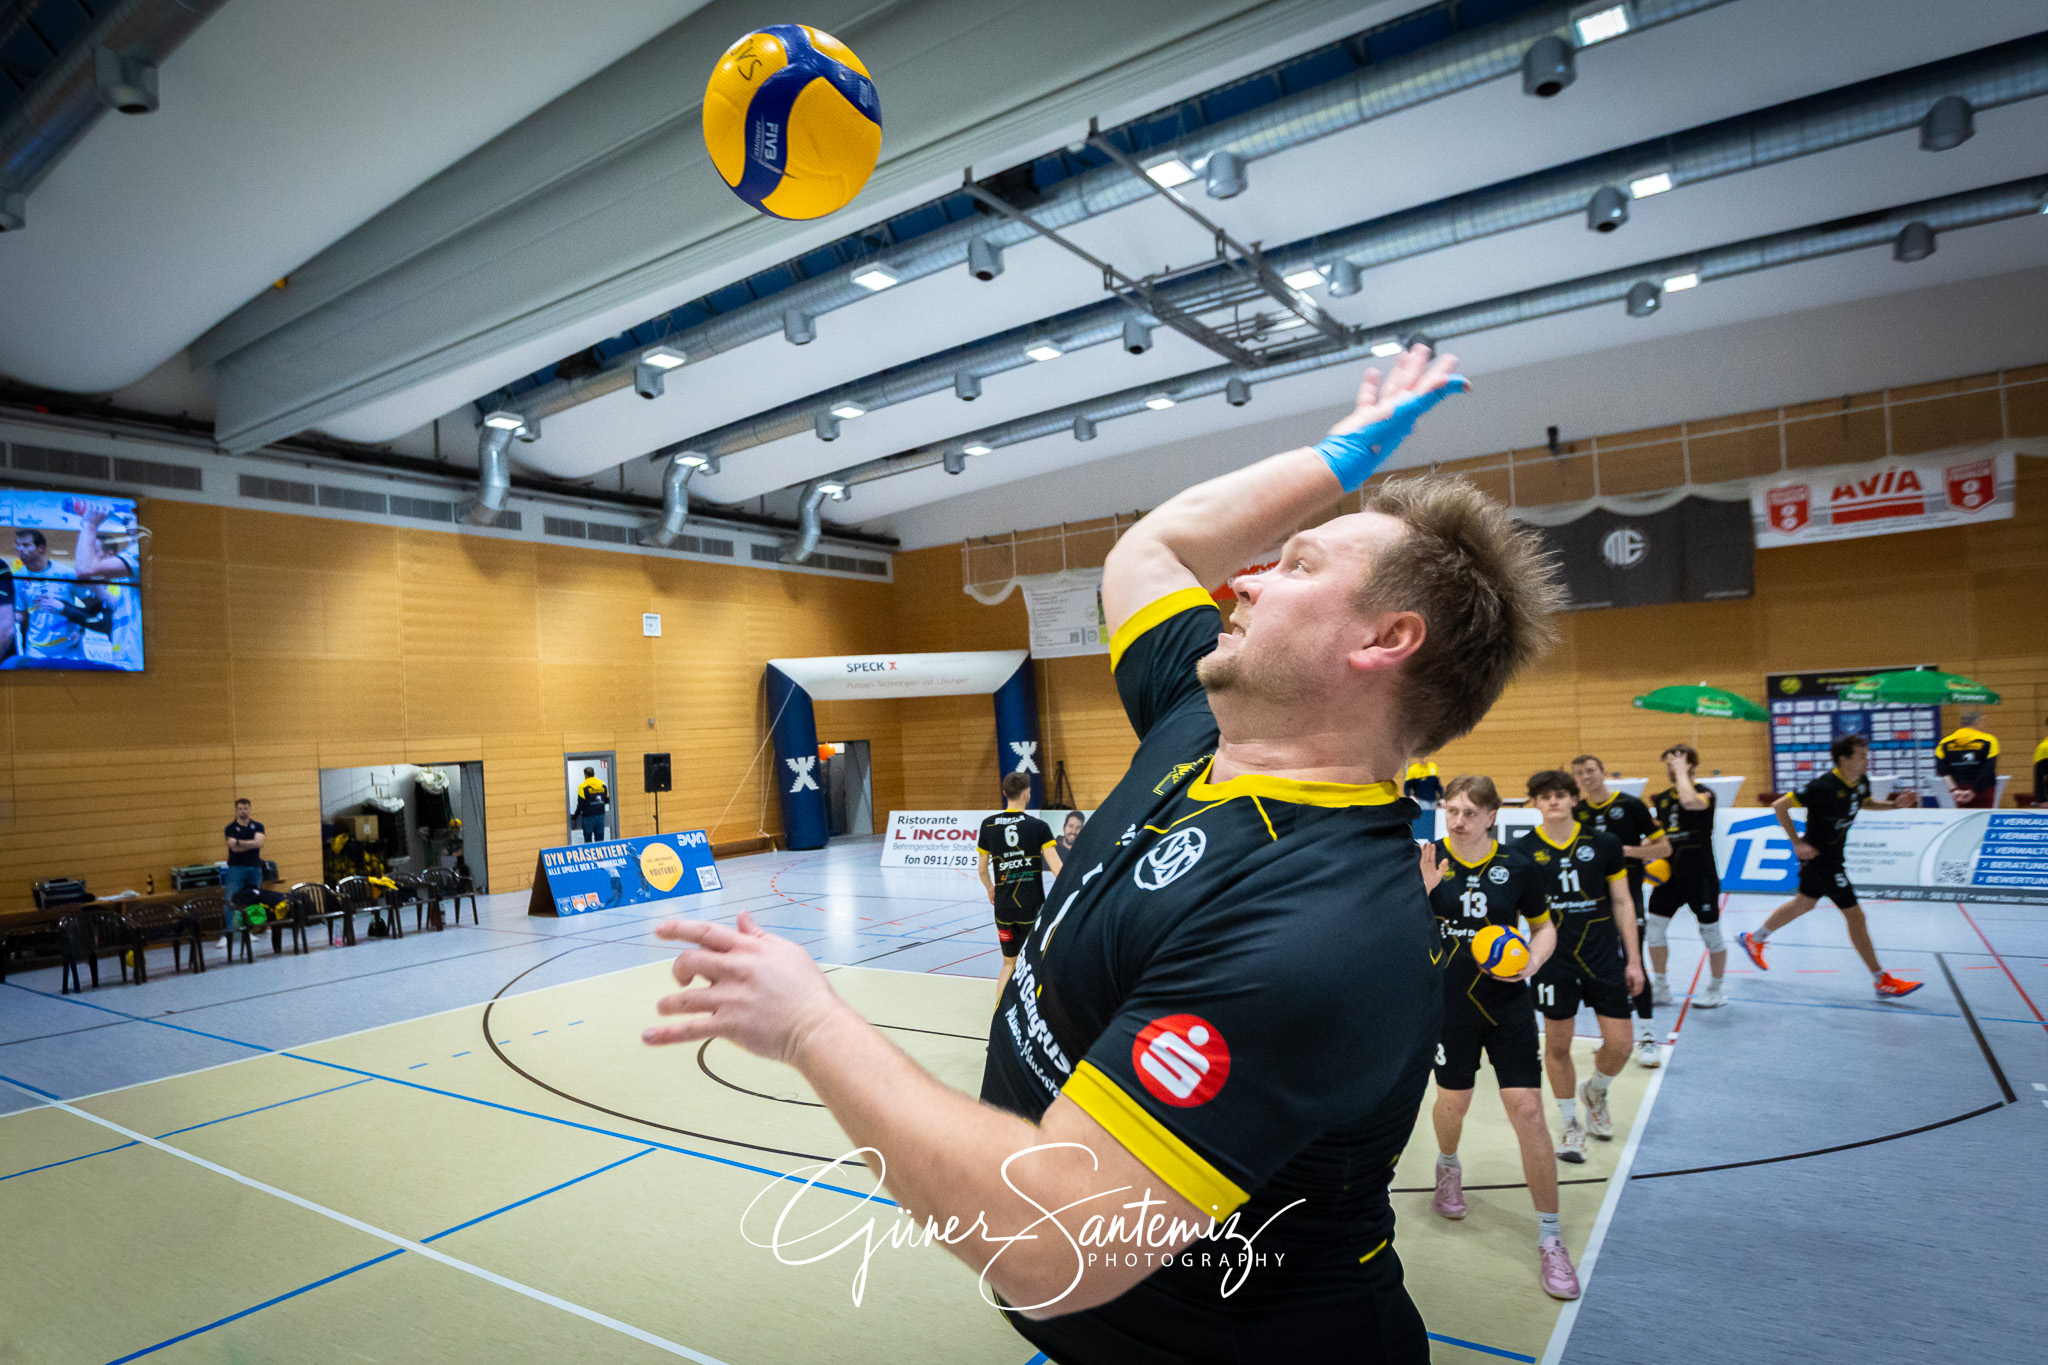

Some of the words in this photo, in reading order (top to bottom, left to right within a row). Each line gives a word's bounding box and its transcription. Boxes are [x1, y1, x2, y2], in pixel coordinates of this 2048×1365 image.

[764, 122, 779, 161] FIVB
[1831, 466, 1923, 501] AVIA
[847, 661, 885, 673] SPECK
[897, 815, 958, 825] Ristorante
[1004, 825, 1019, 847] 6
[544, 852, 565, 867] DYN
[566, 844, 628, 864] PRÄSENTIERT
[893, 843, 950, 852] Behringersdorfer
[952, 843, 976, 852] Straße
[548, 867, 561, 876] ALLE
[561, 864, 579, 874] SPIELE
[579, 862, 591, 871] DER
[904, 854, 921, 864] fon
[923, 855, 968, 867] 0911/50
[999, 859, 1023, 871] SPECK
[1558, 870, 1580, 892] 11
[1459, 891, 1488, 918] 13
[1447, 927, 1468, 938] Zapf
[1537, 983, 1554, 1006] 11
